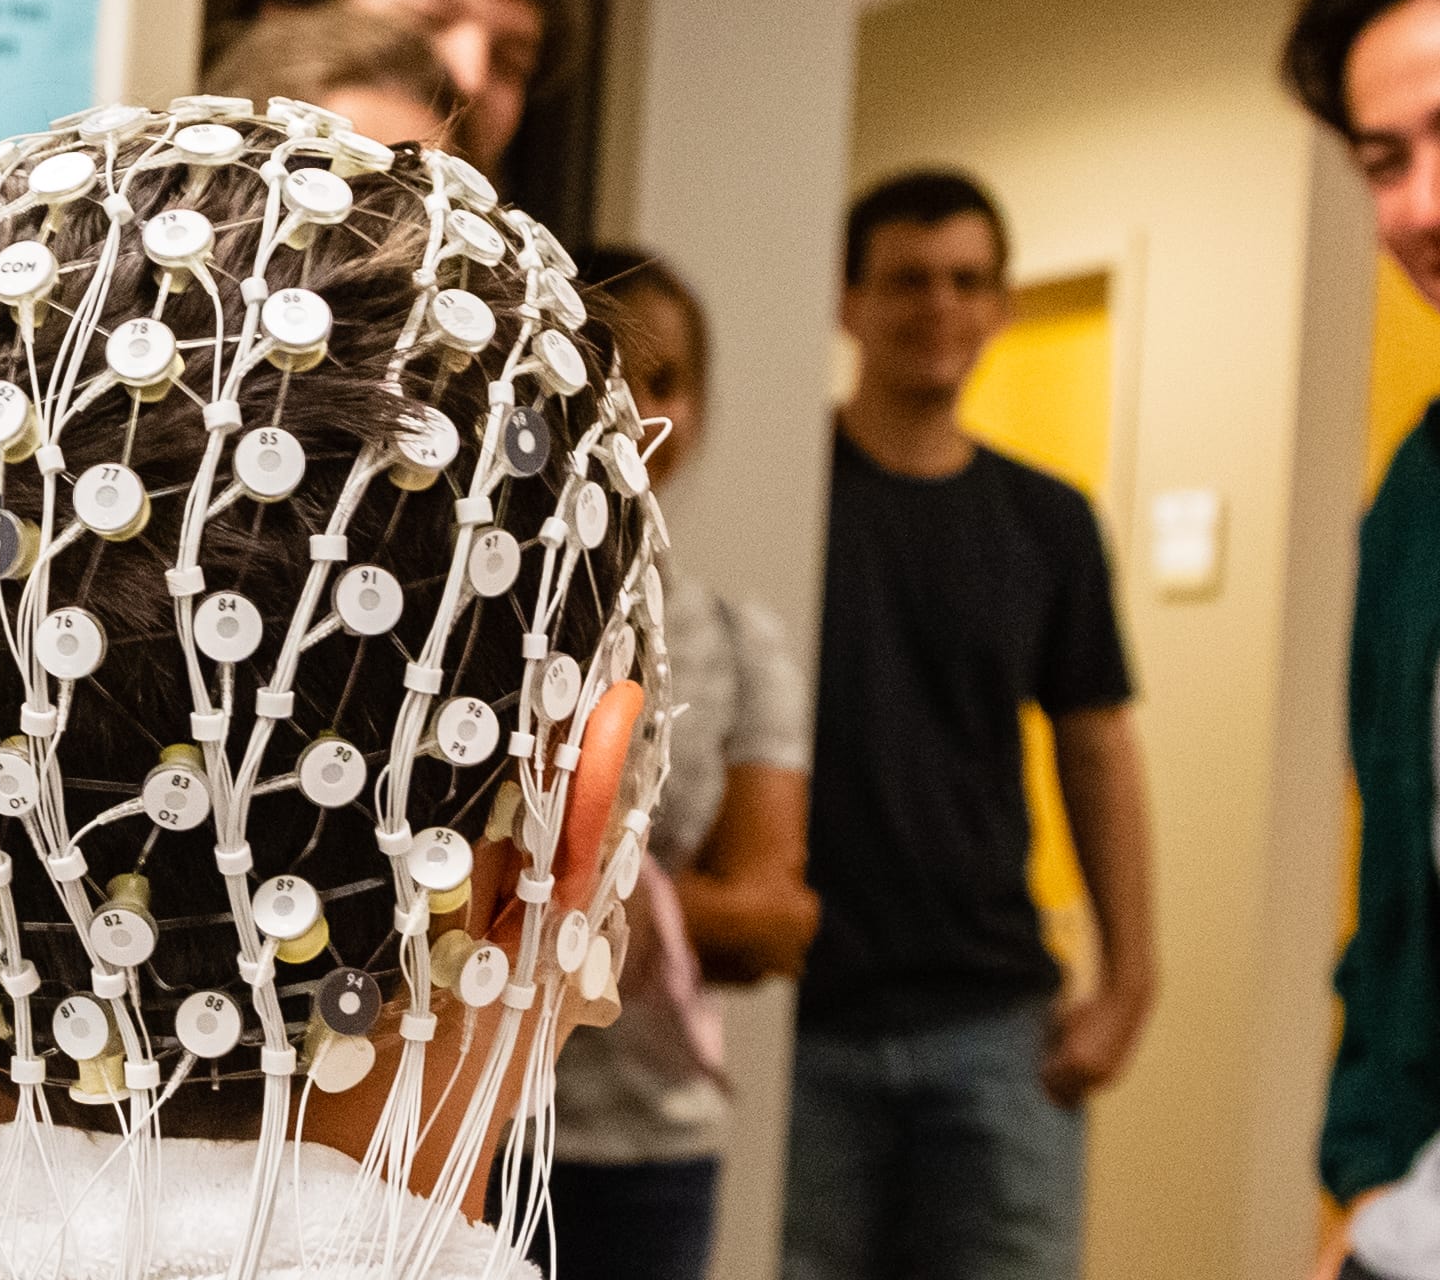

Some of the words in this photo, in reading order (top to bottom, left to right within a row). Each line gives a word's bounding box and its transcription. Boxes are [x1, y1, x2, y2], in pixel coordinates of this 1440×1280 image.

[159, 214, 176, 225] 79
[1, 262, 36, 273] COM
[283, 294, 301, 303] 86
[131, 322, 148, 335] 78
[259, 432, 278, 445] 85
[103, 468, 120, 481] 77
[484, 535, 499, 550] 97
[361, 571, 377, 584] 91
[218, 598, 236, 612] 84
[54, 616, 73, 628] 76
[467, 701, 483, 717] 96
[334, 746, 351, 761] 90
[450, 741, 466, 757] P8
[171, 775, 190, 789] 83
[158, 809, 178, 825] O2
[435, 831, 453, 844] 95
[276, 879, 294, 892] 89
[103, 914, 123, 927] 82
[477, 951, 491, 964] 99
[346, 973, 363, 990] 94
[205, 995, 224, 1011] 88
[61, 1003, 76, 1019] 81
